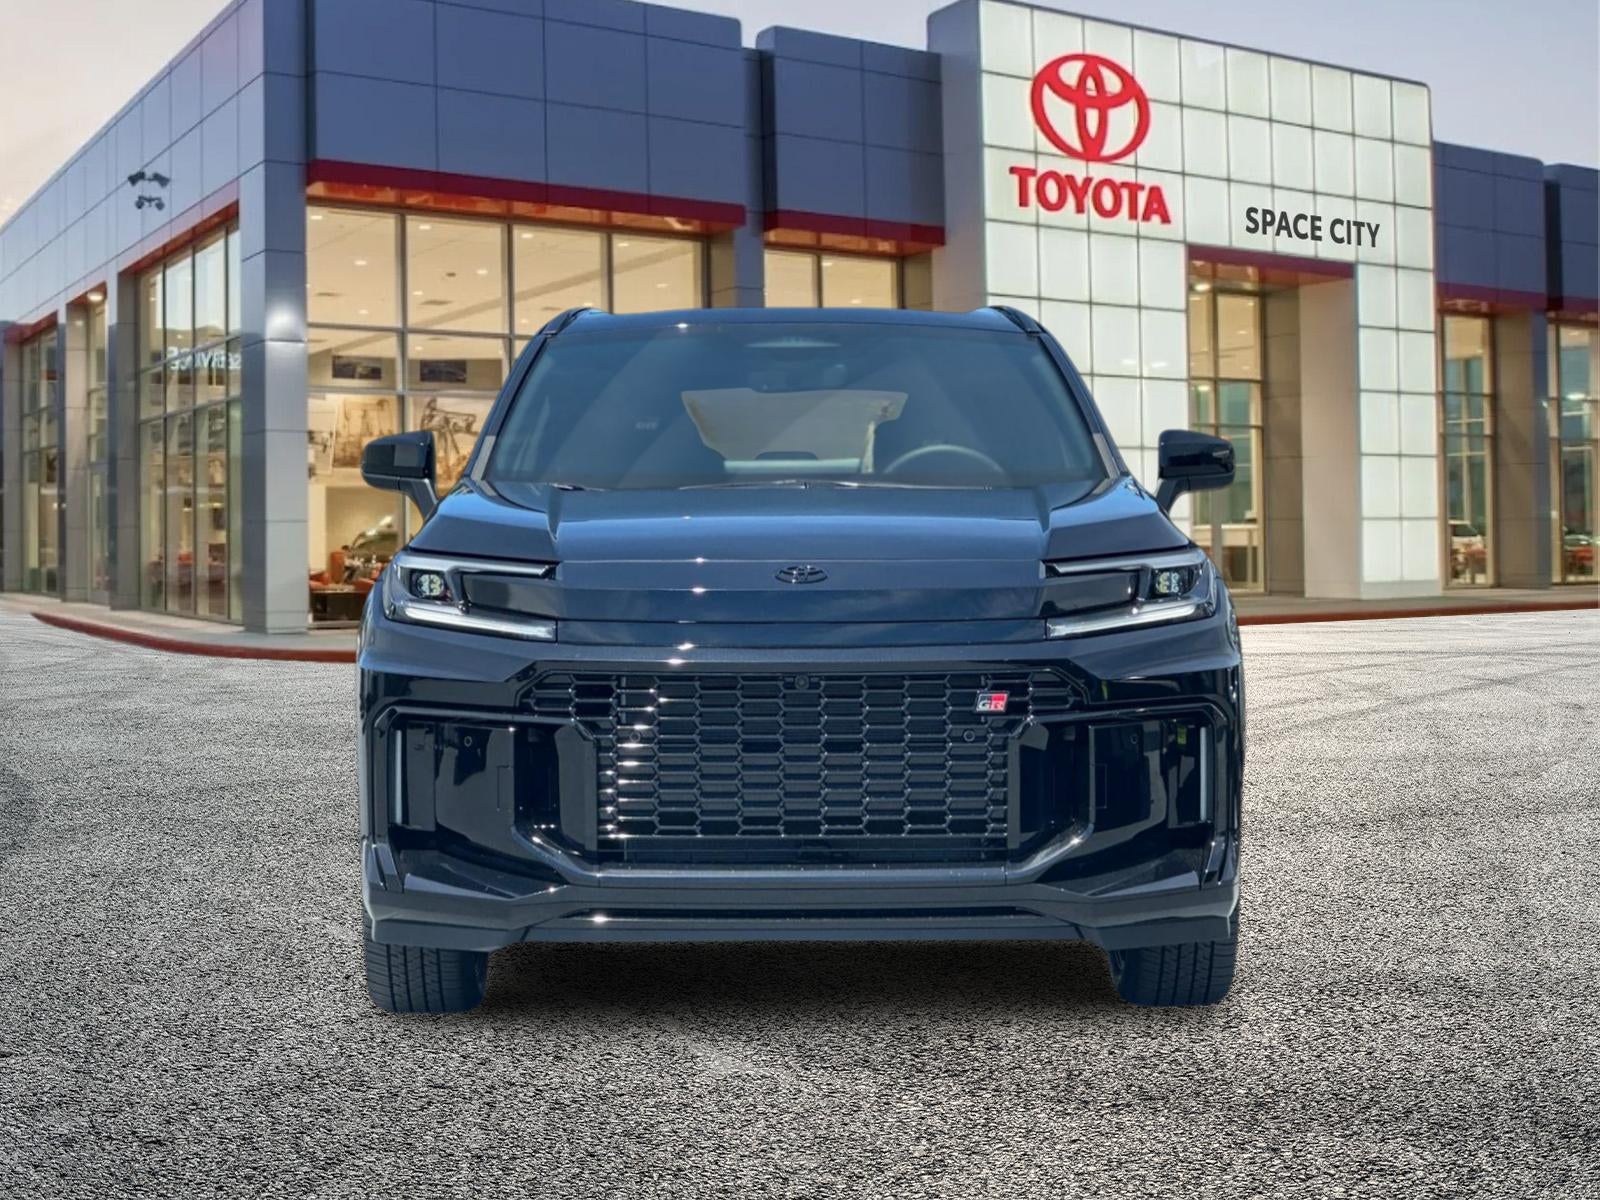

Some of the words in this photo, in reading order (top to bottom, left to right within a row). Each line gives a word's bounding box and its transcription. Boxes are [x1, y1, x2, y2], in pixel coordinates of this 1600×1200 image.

[1009, 166, 1171, 224] TOYOTA
[1245, 206, 1322, 242] SPACE
[1329, 218, 1381, 248] CITY
